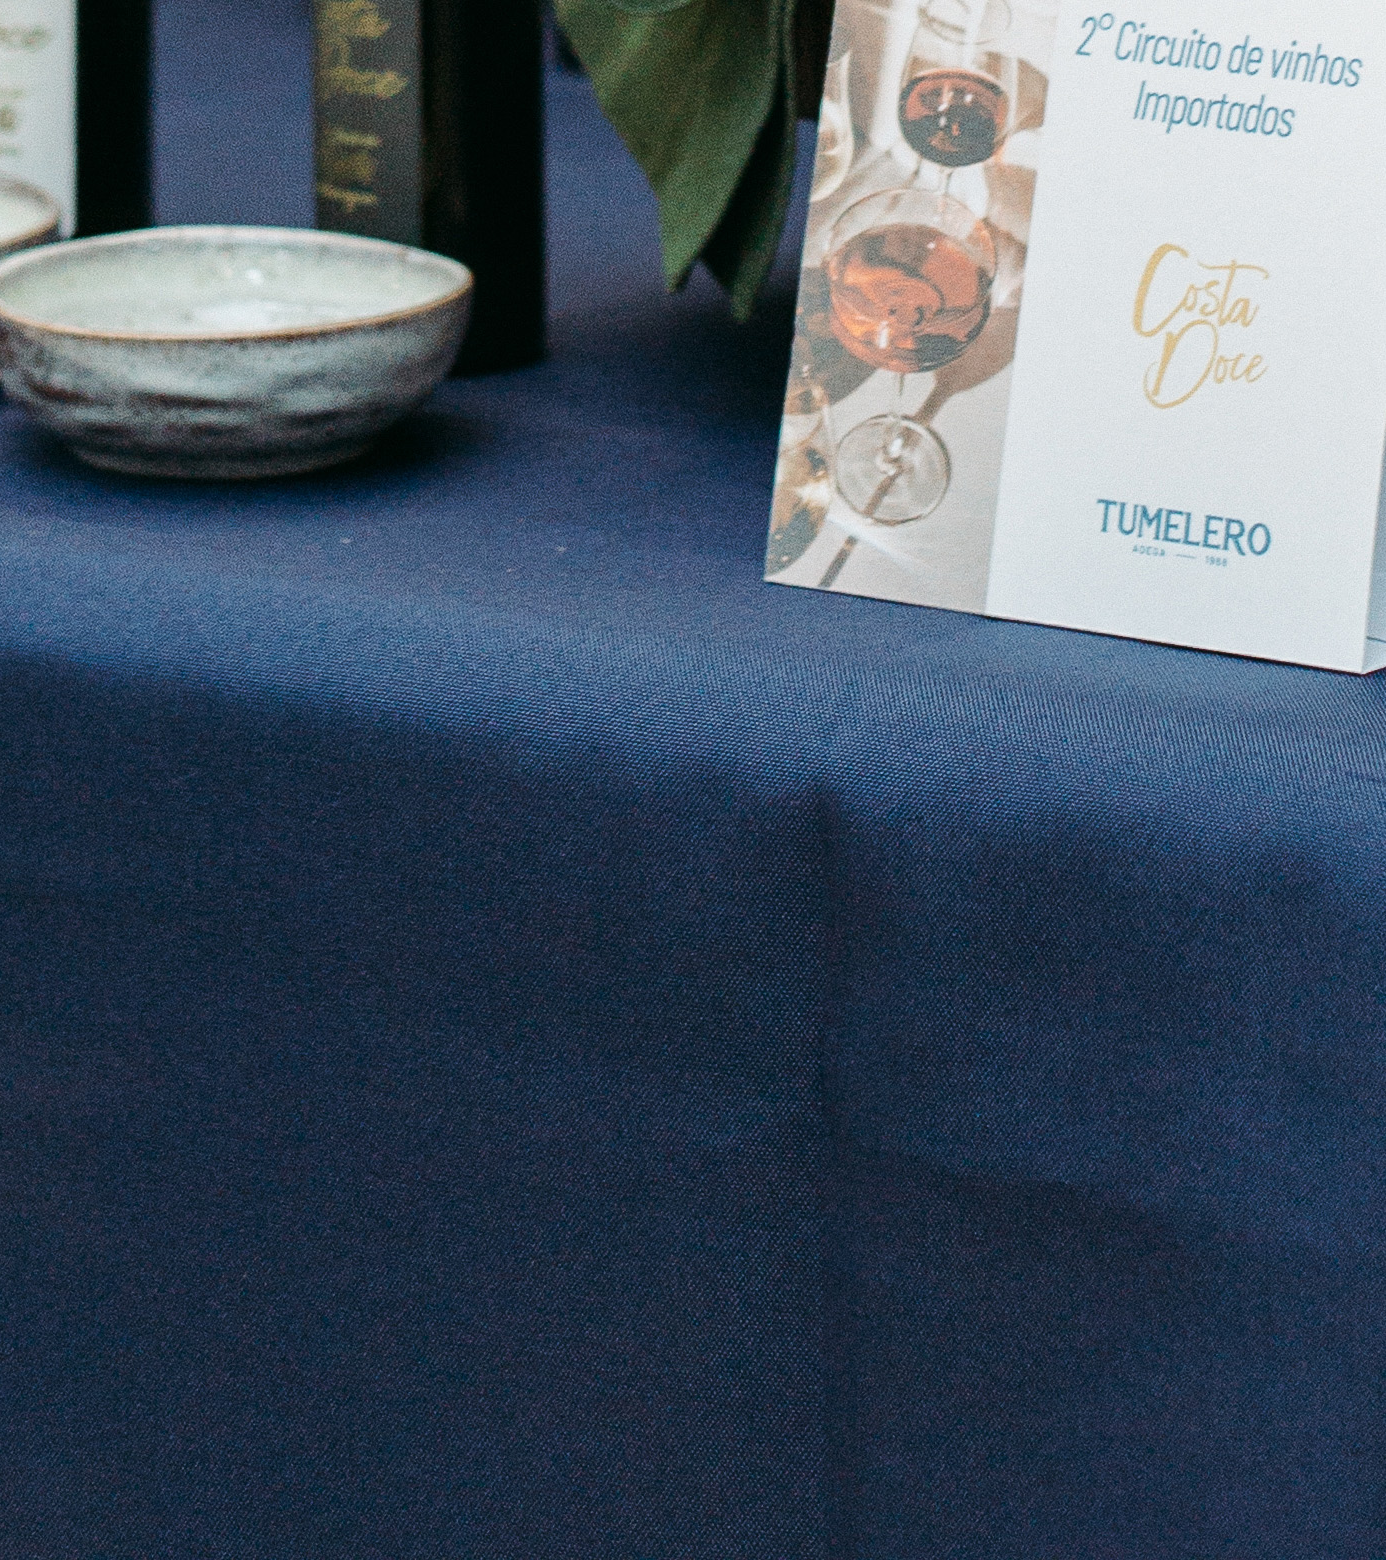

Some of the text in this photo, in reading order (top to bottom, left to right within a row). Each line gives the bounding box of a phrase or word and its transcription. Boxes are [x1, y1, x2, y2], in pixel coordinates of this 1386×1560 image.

[1115, 21, 1222, 71] Circuito
[1227, 35, 1264, 76] de
[1271, 40, 1363, 87] vinhos
[1133, 80, 1296, 137] Importados
[1132, 242, 1269, 337] Costa
[1142, 318, 1269, 409] Doce
[1096, 498, 1272, 556] TUMELERO
